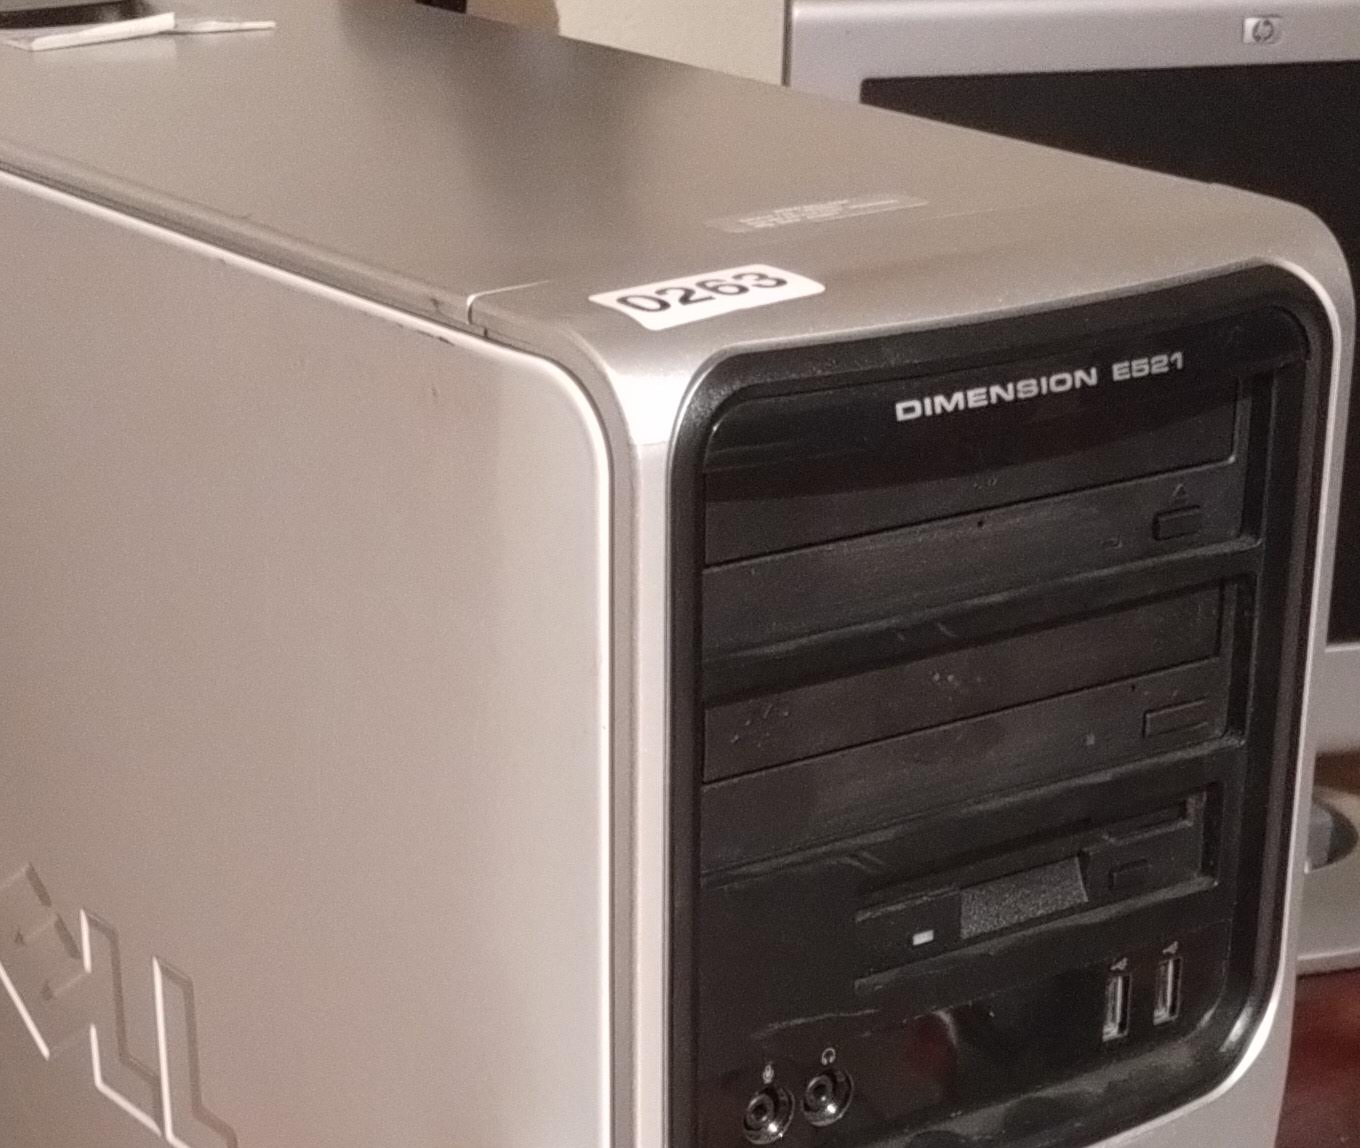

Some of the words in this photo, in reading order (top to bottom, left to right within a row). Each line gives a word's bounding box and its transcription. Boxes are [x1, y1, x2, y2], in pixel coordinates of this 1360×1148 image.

[616, 271, 788, 313] 0263
[895, 367, 1098, 422] DIMENSION
[1112, 351, 1184, 382] E521
